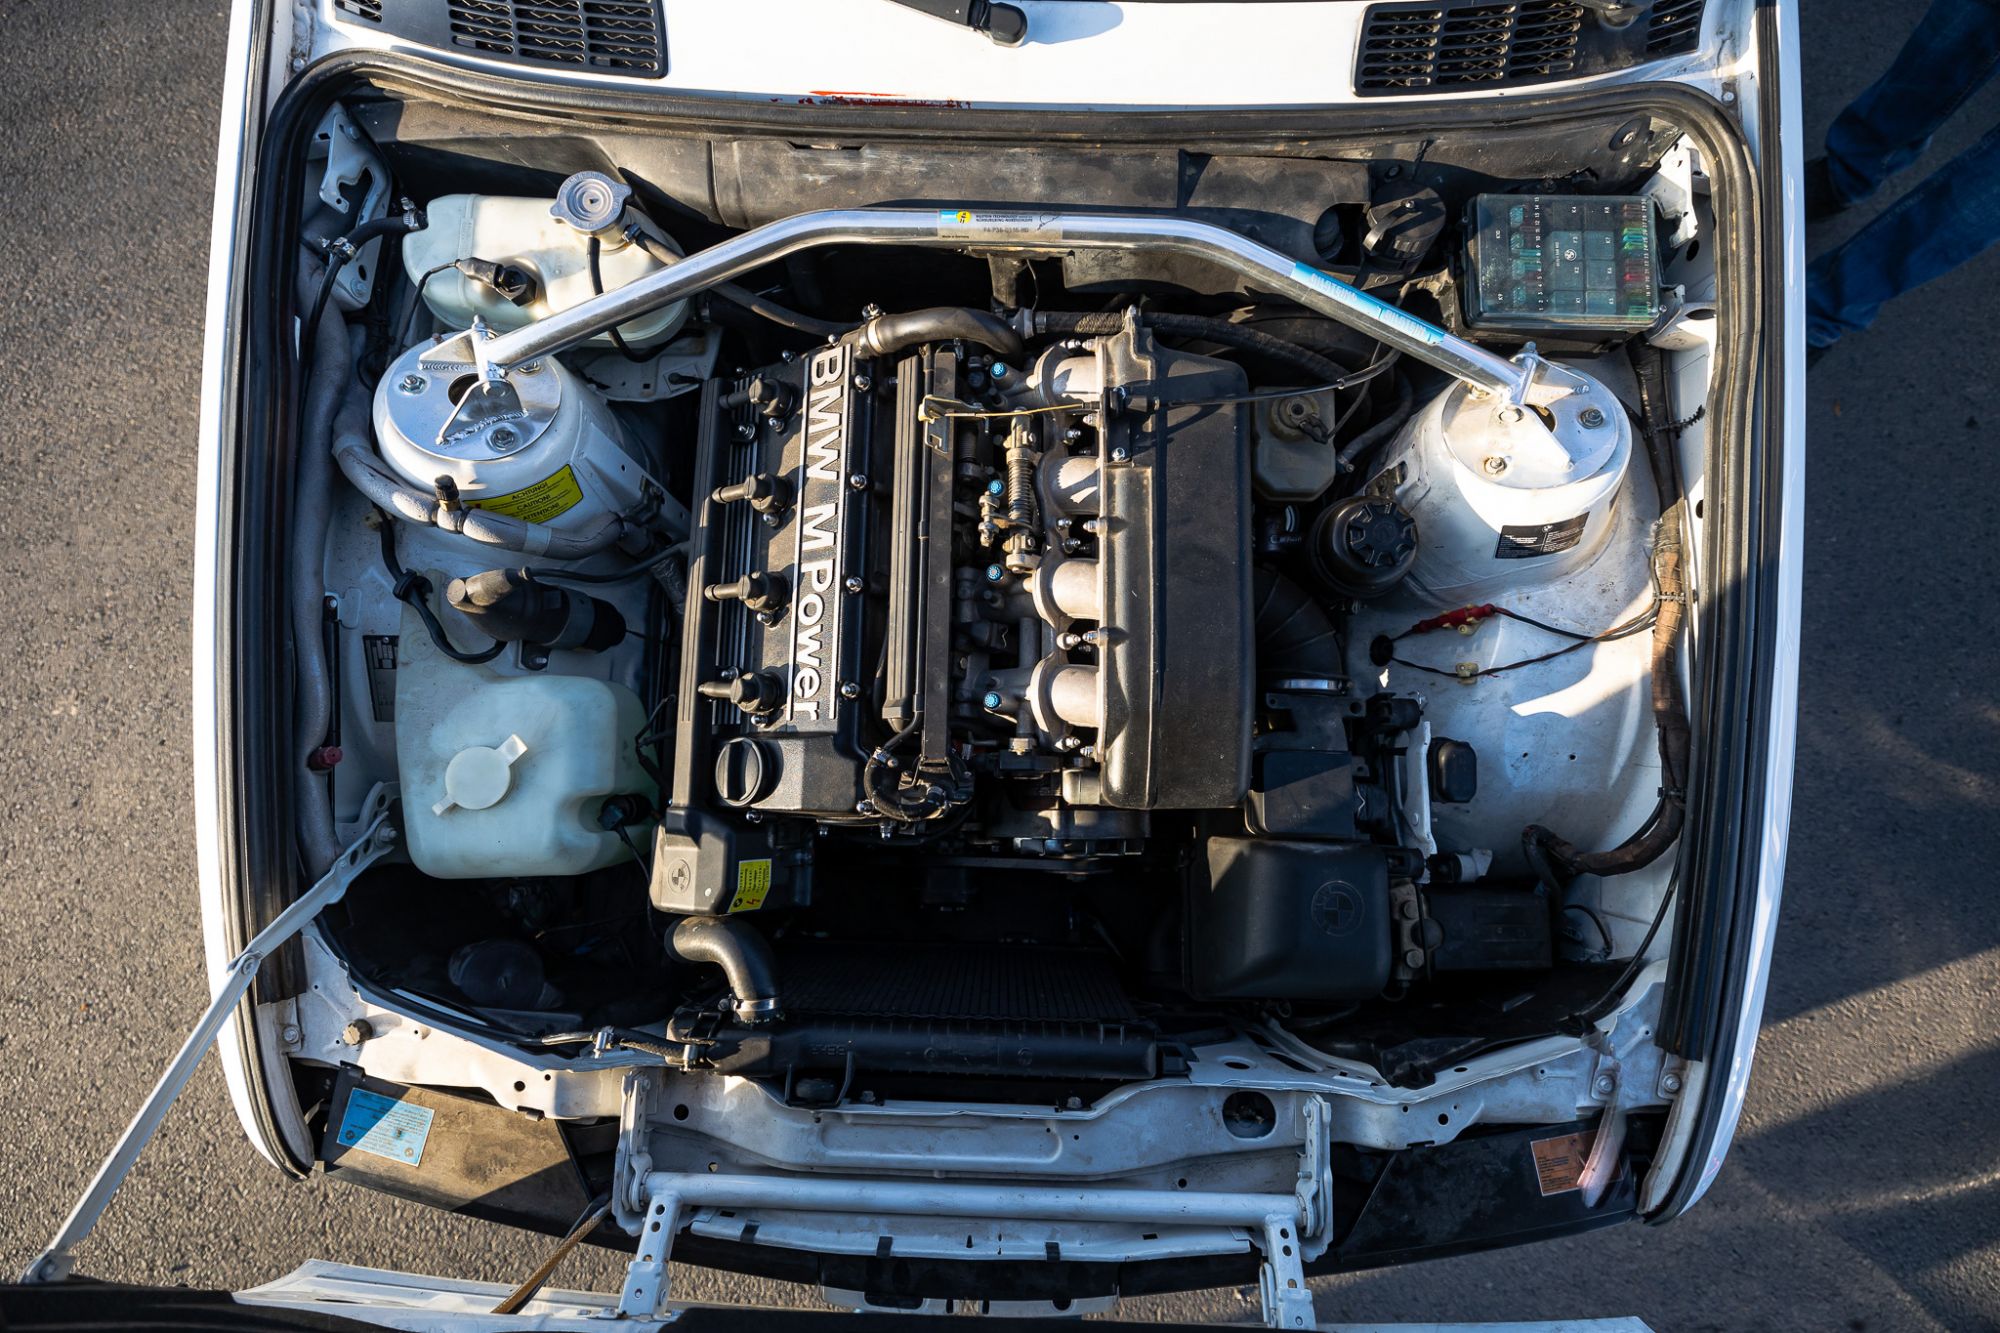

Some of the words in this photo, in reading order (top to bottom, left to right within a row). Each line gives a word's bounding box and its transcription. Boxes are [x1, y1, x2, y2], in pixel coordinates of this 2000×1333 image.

[806, 345, 843, 480] BMW
[512, 482, 548, 500] ACHTUNG!
[517, 494, 551, 510] CAUTION!
[523, 502, 560, 520] ATTENTION!
